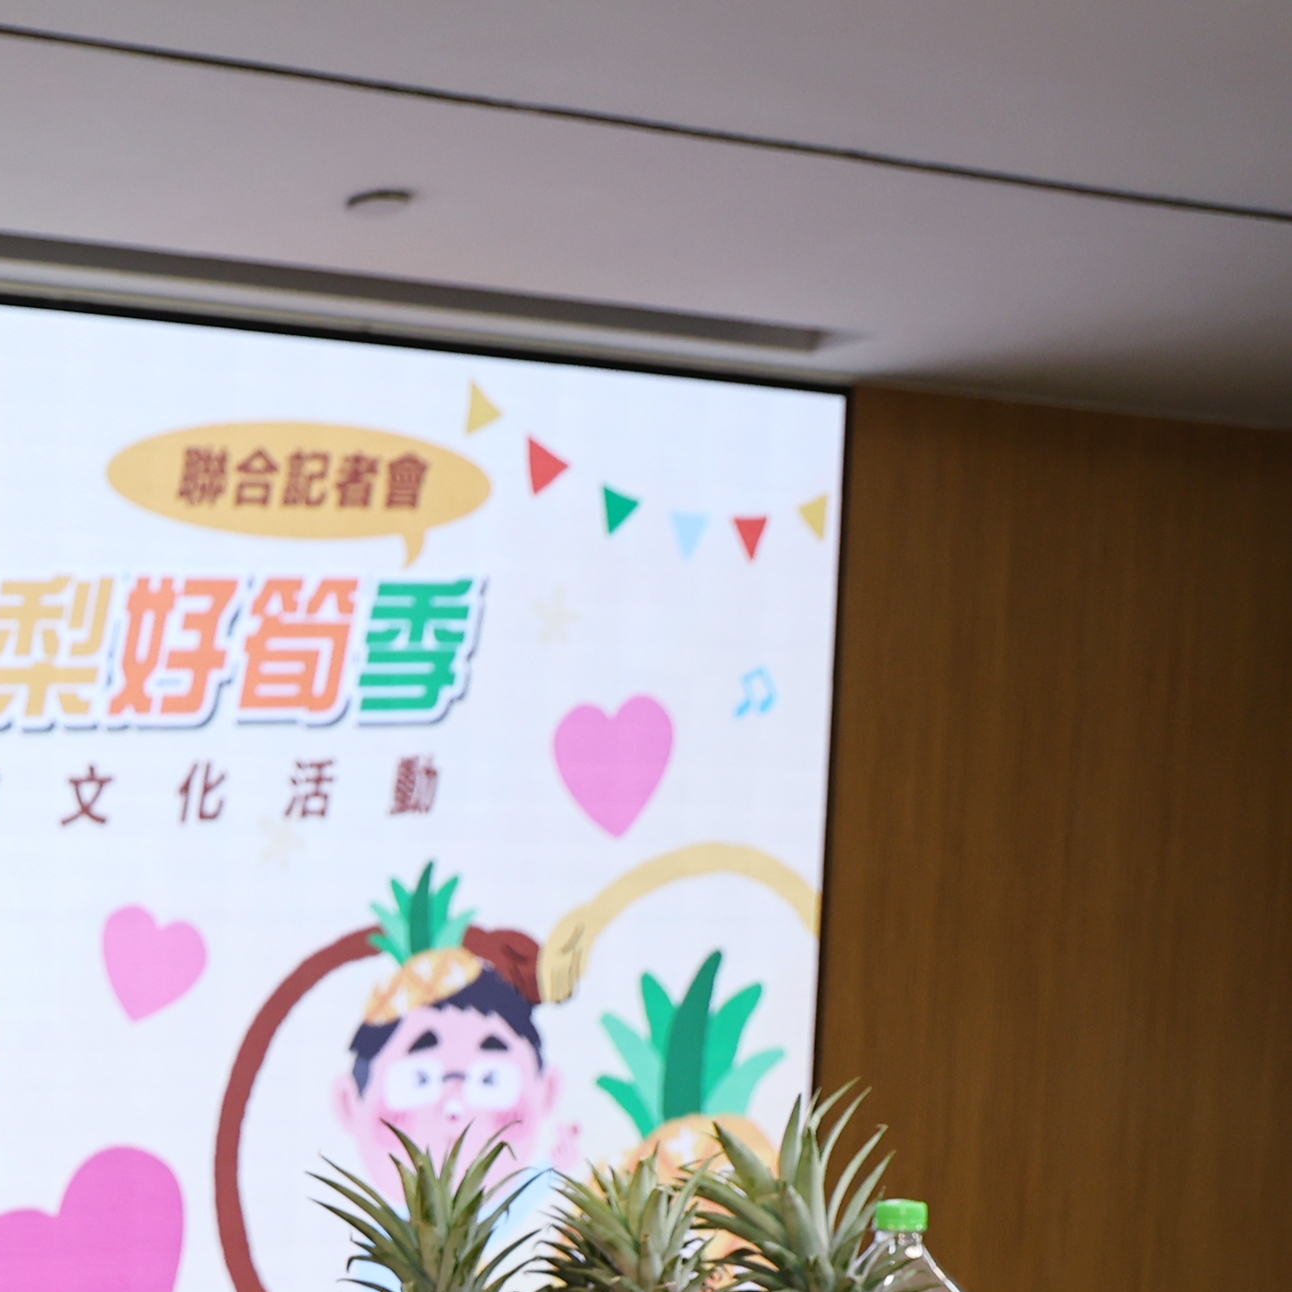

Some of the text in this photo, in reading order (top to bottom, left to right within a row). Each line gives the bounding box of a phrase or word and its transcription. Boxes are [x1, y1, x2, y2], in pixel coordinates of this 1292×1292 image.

[176, 446, 429, 510] 聯合記者會
